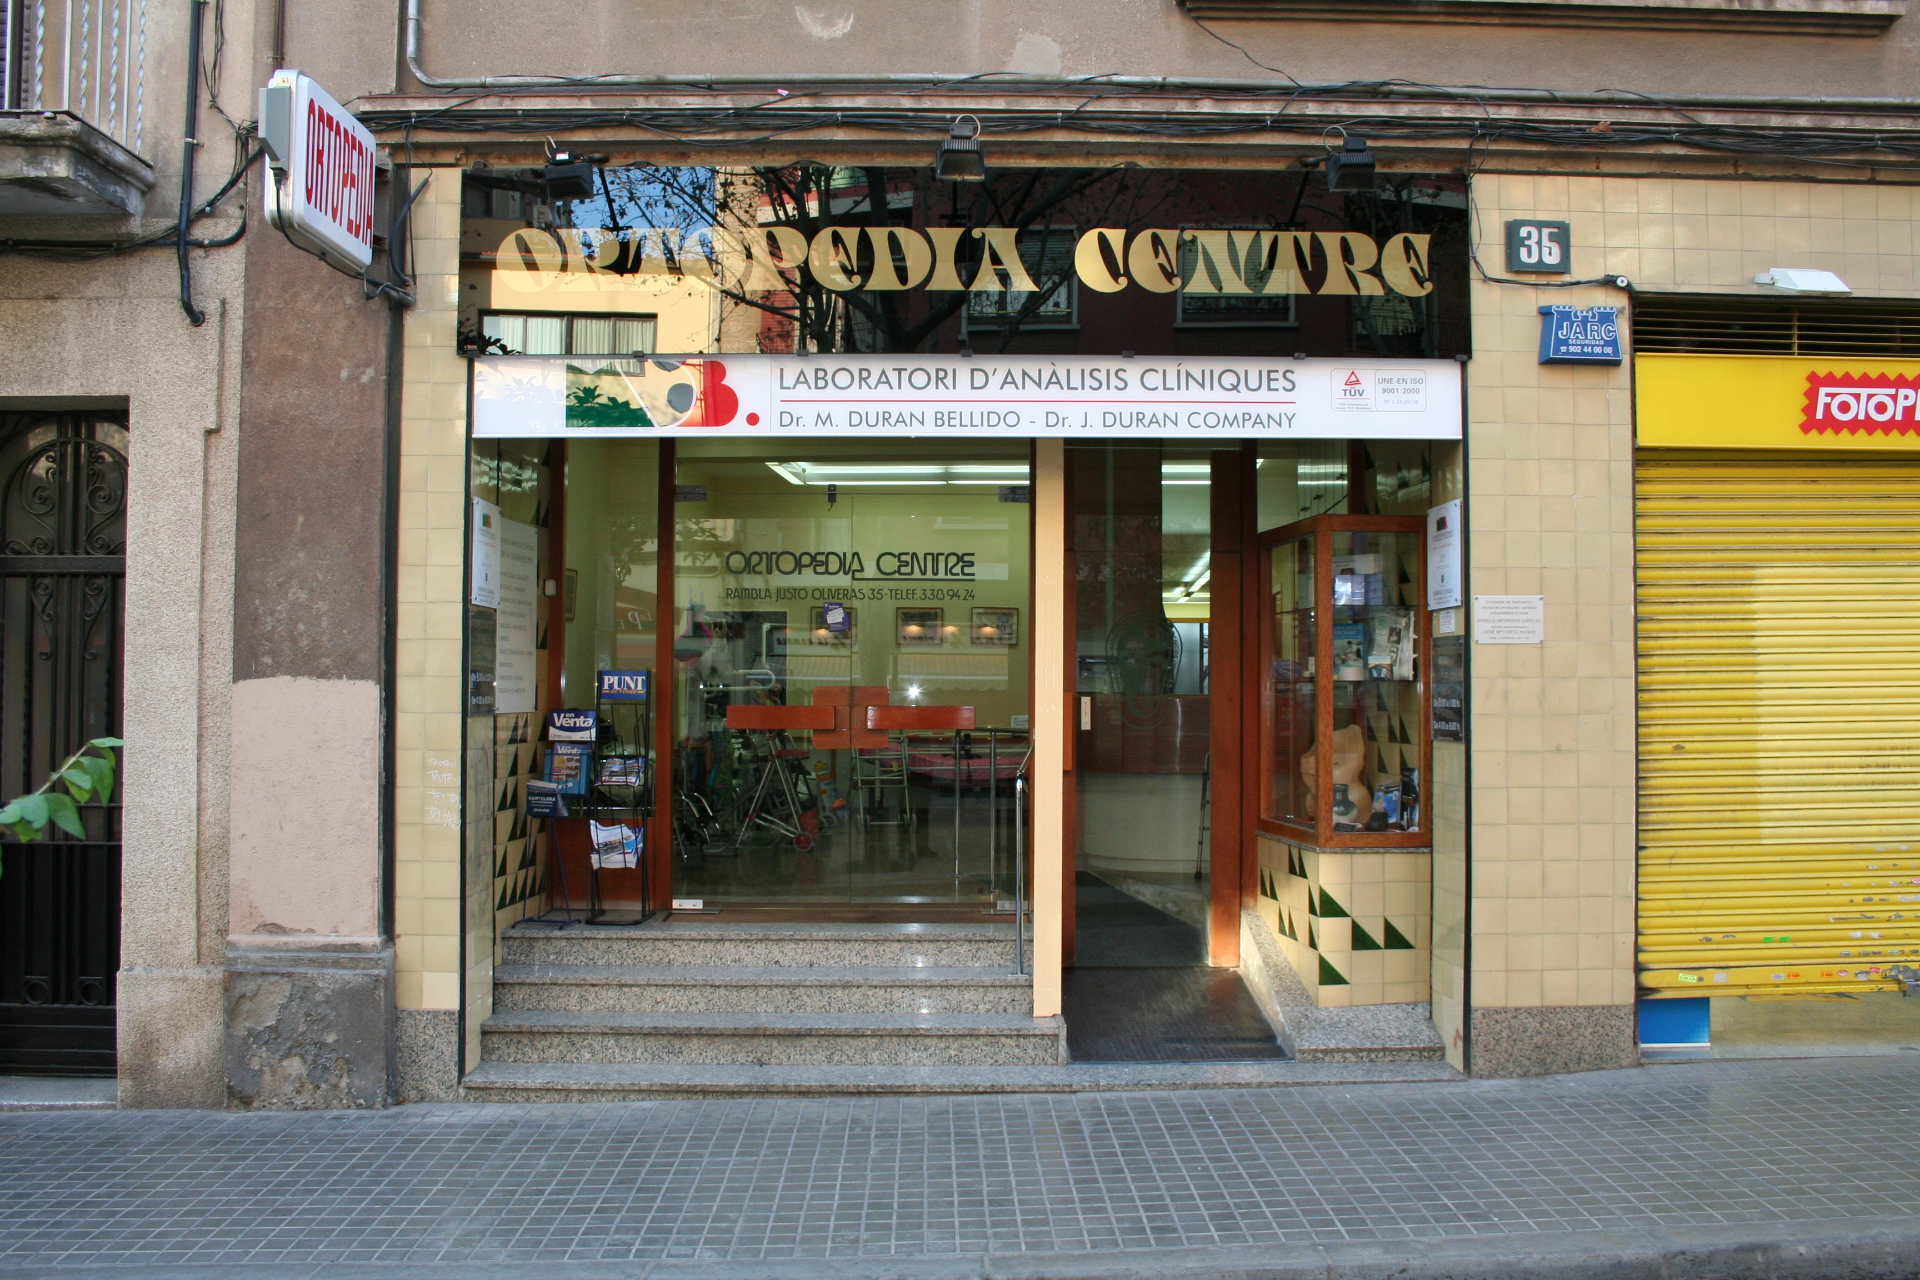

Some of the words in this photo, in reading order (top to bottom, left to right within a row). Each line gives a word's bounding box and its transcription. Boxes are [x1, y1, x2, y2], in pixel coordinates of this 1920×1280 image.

[1519, 225, 1562, 265] 35
[496, 227, 1040, 293] ORTOPEDIA
[1074, 227, 1434, 298] CENTRE
[1558, 321, 1616, 341] JARC
[1568, 345, 1582, 353] 902
[1593, 346, 1603, 354] 00
[1603, 346, 1613, 354] 00
[778, 367, 958, 391] LABORATORI
[970, 362, 1129, 392] D'ANÀLISIS
[1139, 362, 1297, 394] CLÍNIQUES
[1377, 377, 1408, 385] UNE-EN
[1410, 377, 1424, 385] ISO
[1341, 386, 1365, 397] TÜV
[1381, 387, 1420, 395] 9001:2000
[778, 410, 807, 428] Dr.
[814, 410, 840, 428] M.
[848, 410, 926, 428] DURAN
[934, 411, 1021, 428] BELLIDO
[1045, 411, 1073, 429] Dr.
[1080, 411, 1094, 429] J.
[1102, 411, 1179, 429] DURAN
[1187, 412, 1297, 430] COMPANY
[725, 550, 865, 576] ORTOPEDIA
[875, 551, 976, 577] CENTRE
[725, 587, 772, 601] RAMBLA
[775, 587, 809, 603] JUSTO
[811, 587, 866, 601] OLIVERAS
[946, 588, 962, 601] 94
[961, 588, 976, 601] 24
[603, 675, 646, 691] PUNT
[553, 713, 594, 728] Venta
